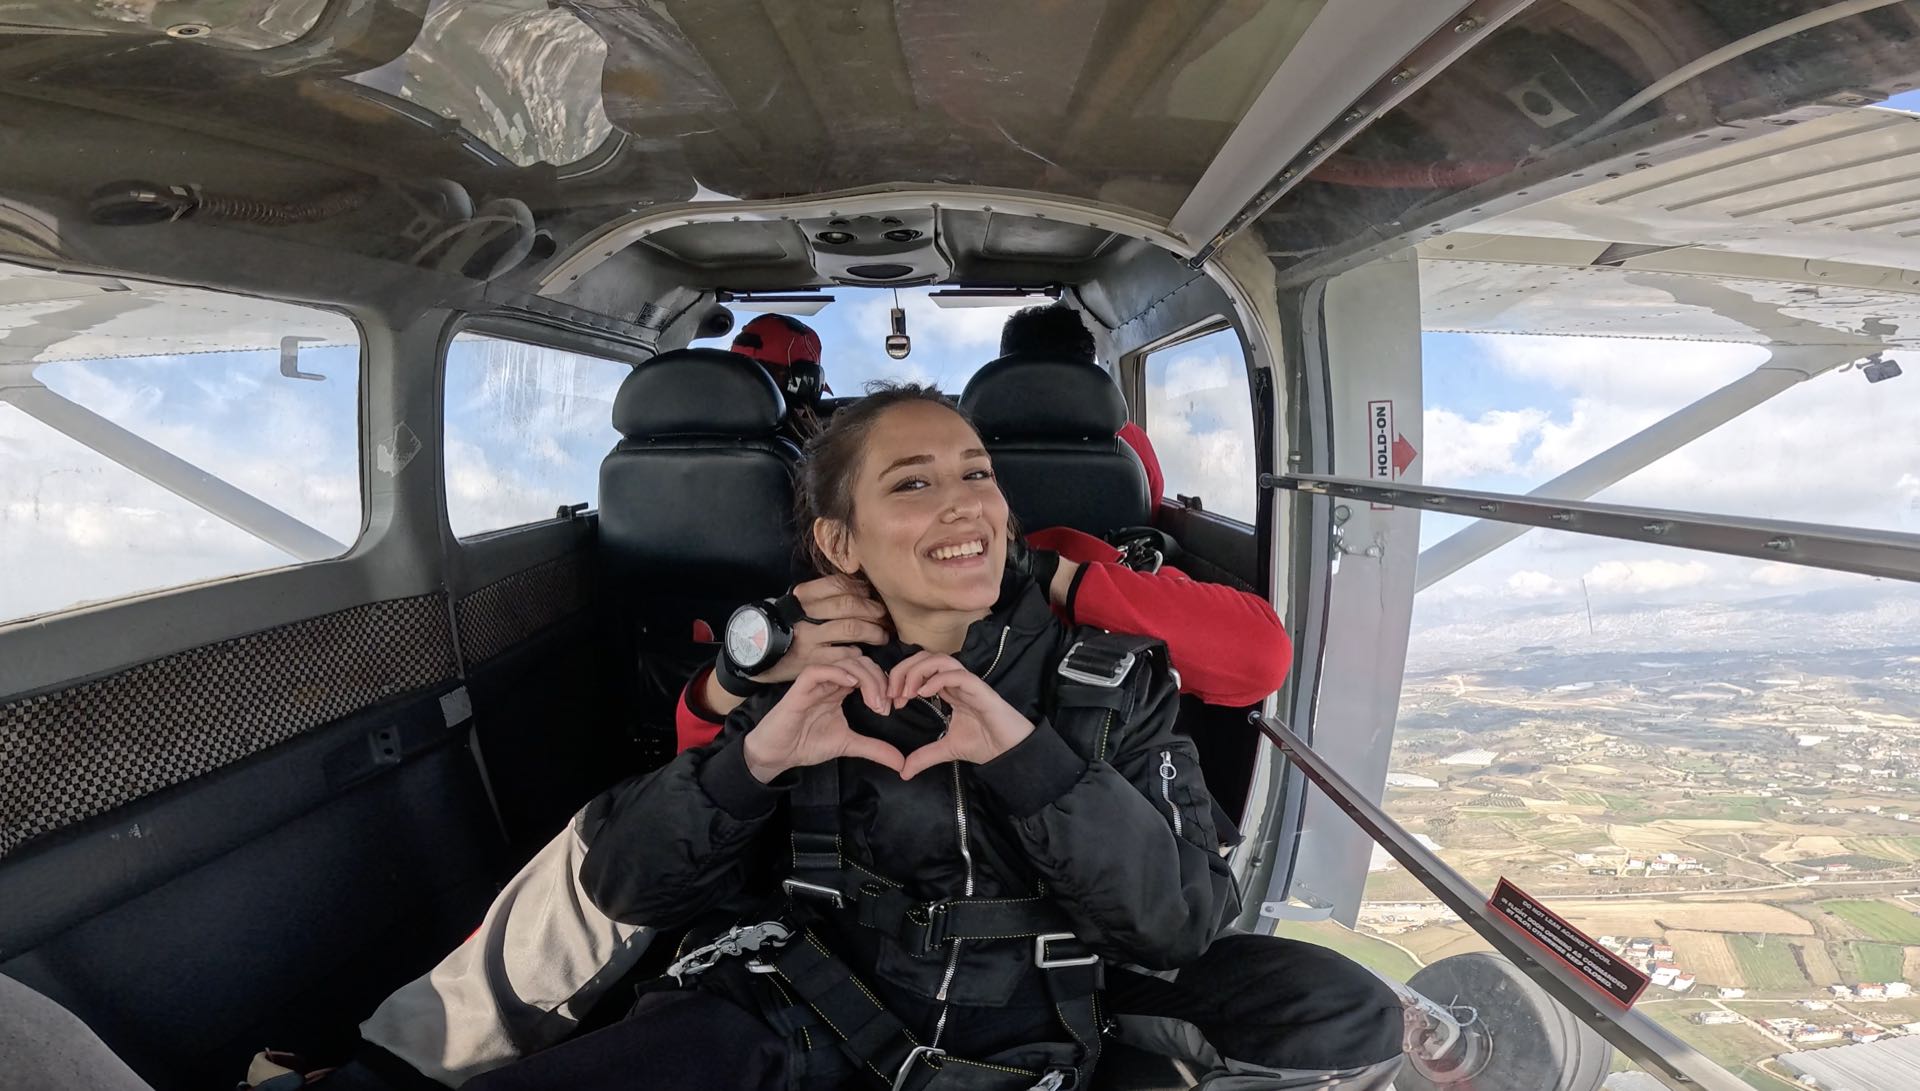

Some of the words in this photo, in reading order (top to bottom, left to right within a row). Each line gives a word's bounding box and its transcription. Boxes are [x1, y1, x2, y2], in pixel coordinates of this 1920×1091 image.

[1376, 406, 1388, 477] HOLD-ON
[1526, 916, 1545, 932] DOOR
[1544, 930, 1573, 952] OPENING
[1571, 950, 1583, 959] AS
[1582, 957, 1628, 991] COMMANDED
[1531, 927, 1567, 955] OTHERWISE
[1565, 952, 1584, 967] KEEP
[1532, 907, 1546, 918] NOT
[1544, 916, 1562, 930] LEAN
[1560, 928, 1590, 949] AGAINST
